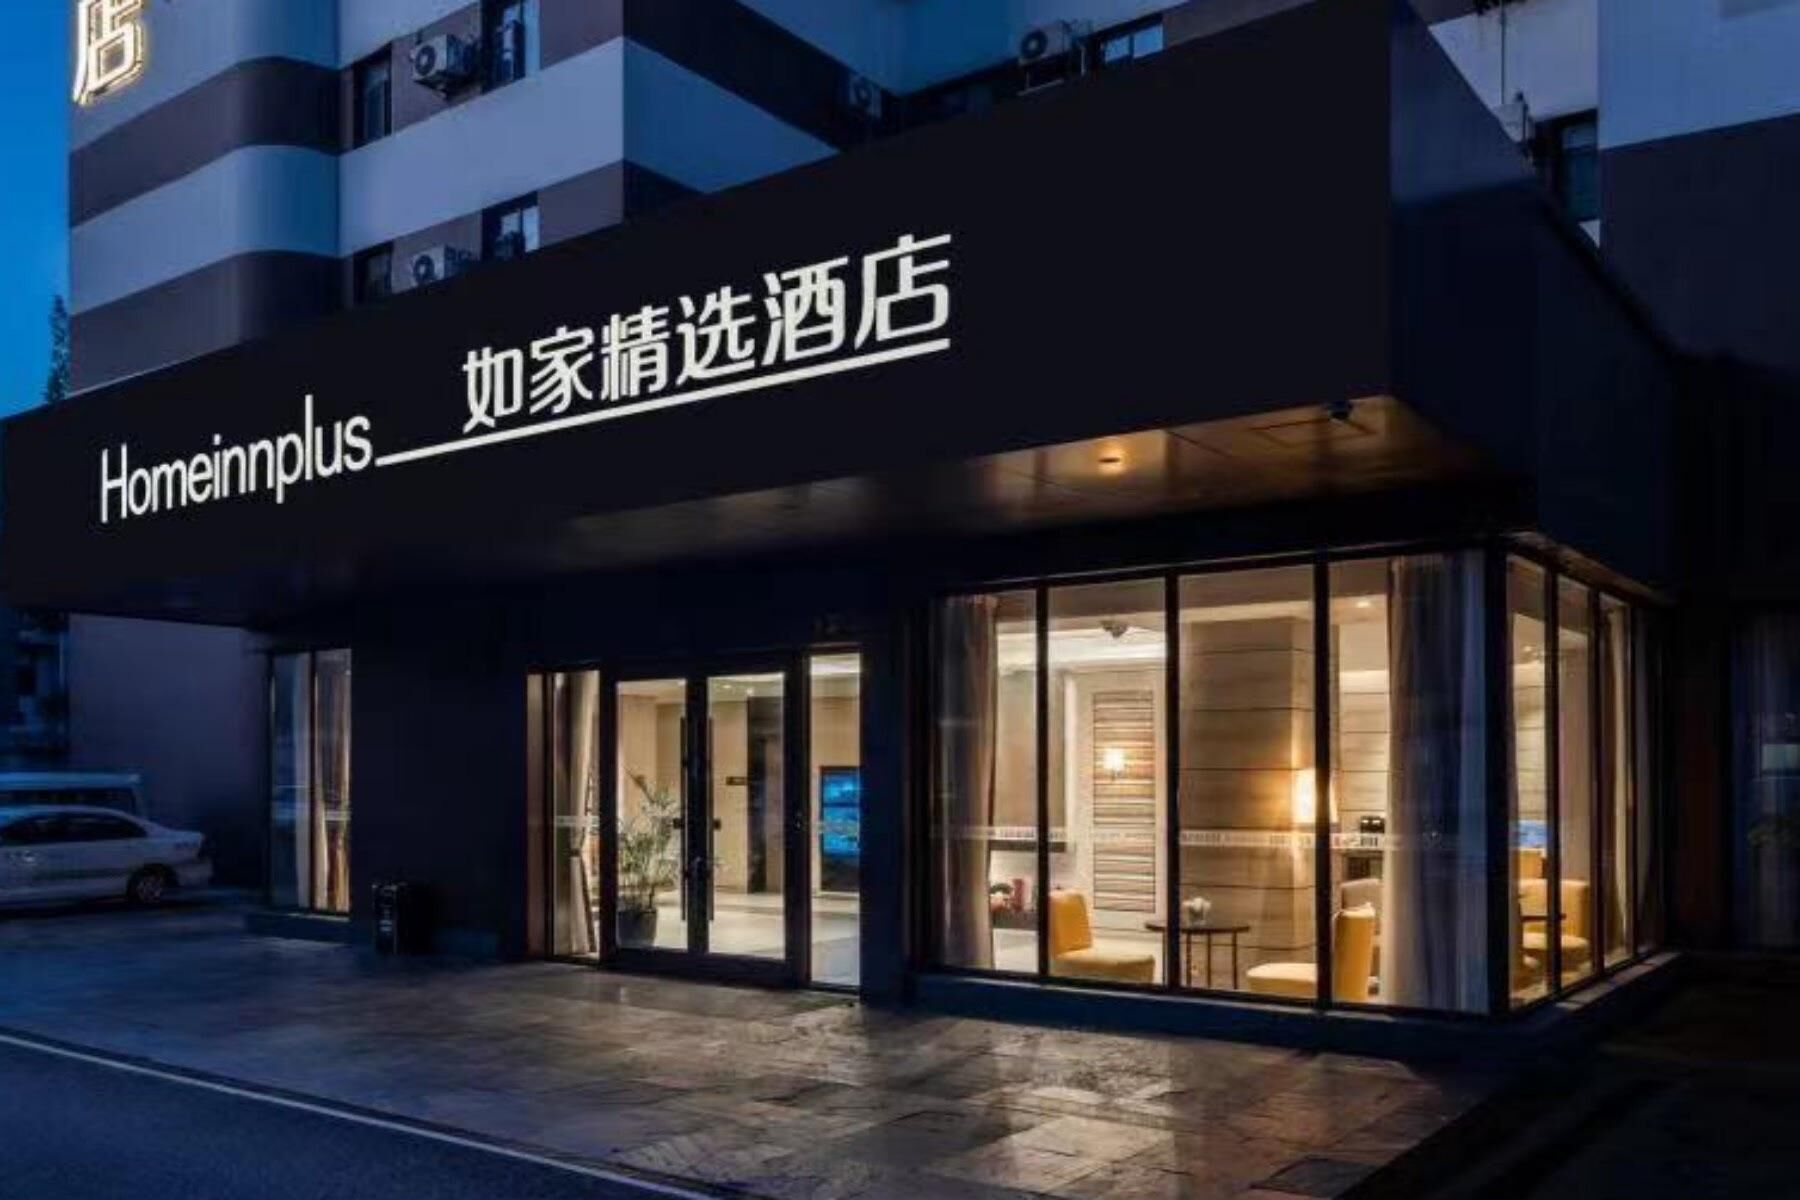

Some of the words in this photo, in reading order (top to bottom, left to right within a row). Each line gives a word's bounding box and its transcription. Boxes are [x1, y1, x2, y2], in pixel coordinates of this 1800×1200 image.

[462, 233, 952, 434] 如家精选酒店
[101, 394, 373, 524] Homeinnplus
